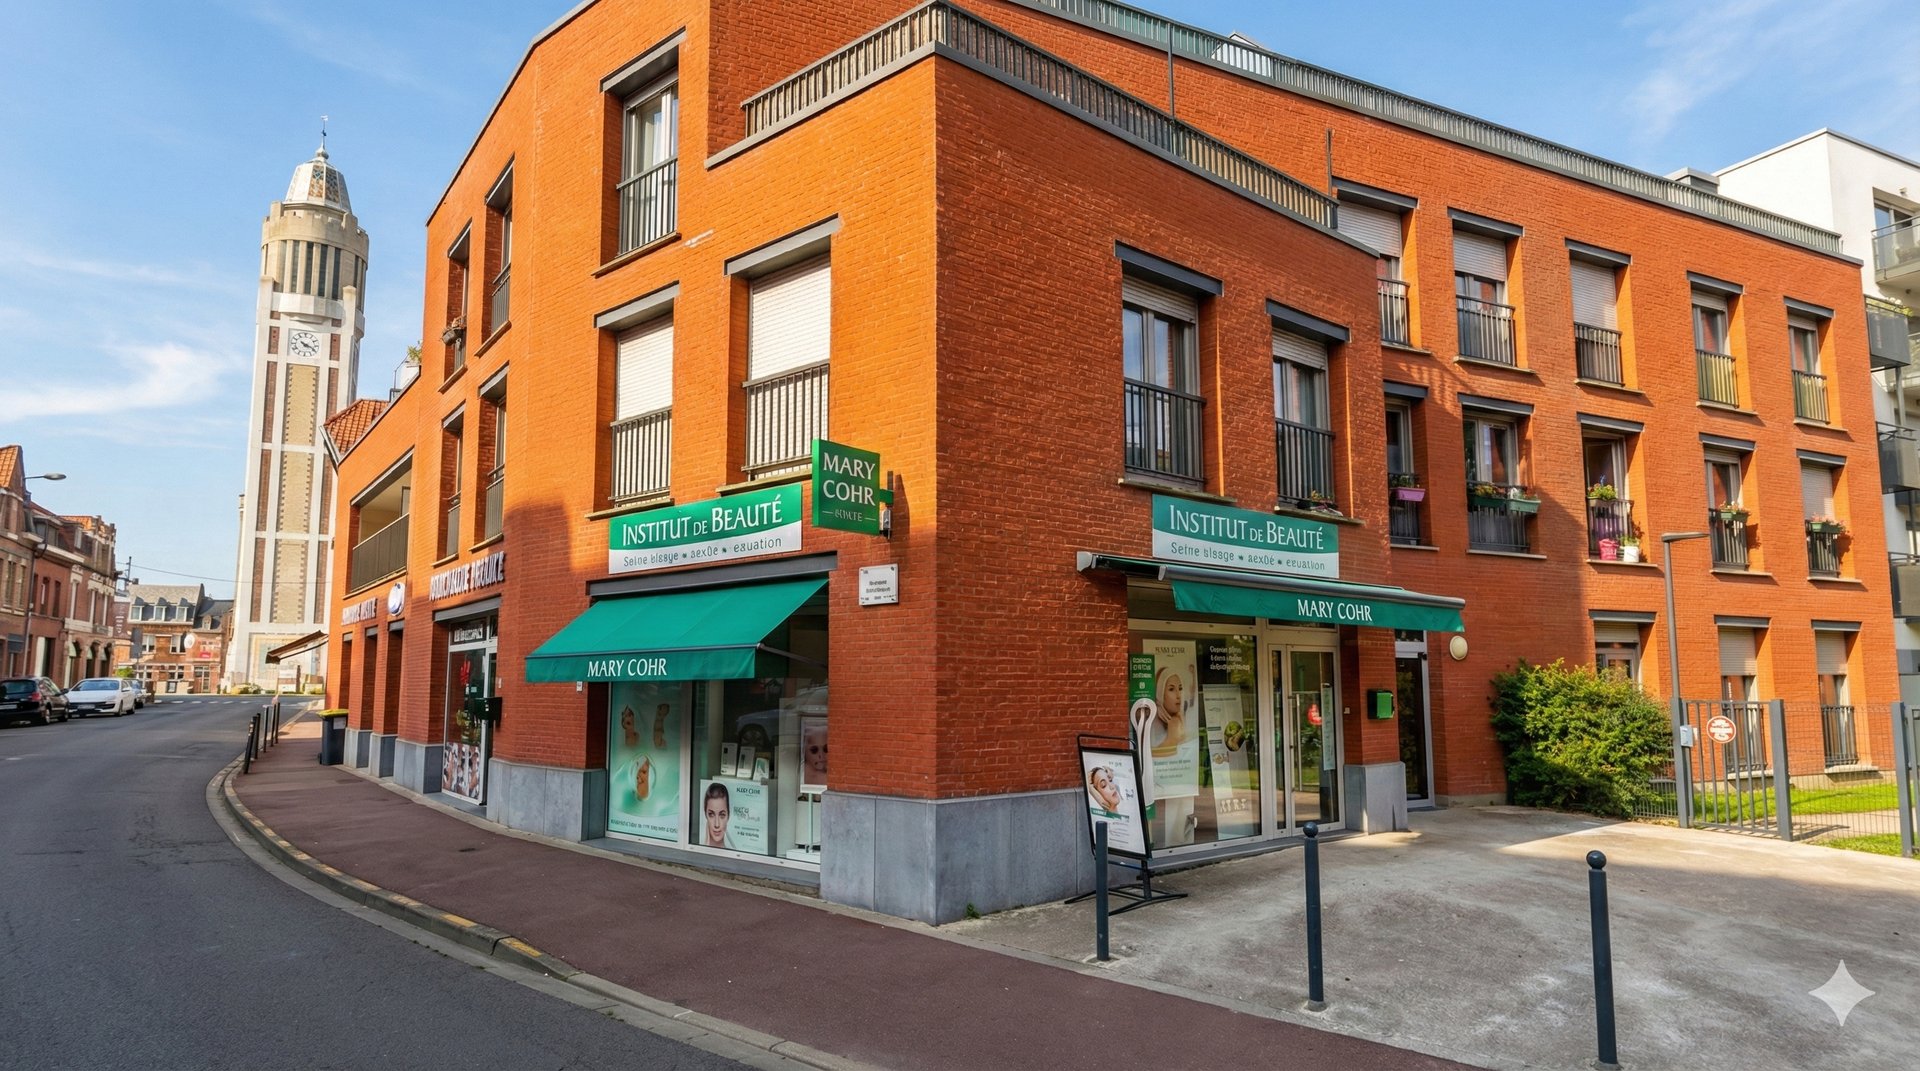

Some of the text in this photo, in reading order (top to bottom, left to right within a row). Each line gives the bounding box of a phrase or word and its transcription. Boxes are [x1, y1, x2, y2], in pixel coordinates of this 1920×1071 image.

[823, 452, 876, 480] MARY
[823, 479, 876, 506] COHR
[622, 494, 783, 546] INSTITUT DE BEAUTÉ
[1169, 505, 1324, 550] INSTITUT DE BEAUTÉ
[1297, 599, 1373, 622] MARY COHR
[587, 658, 667, 678] MARY COHR
